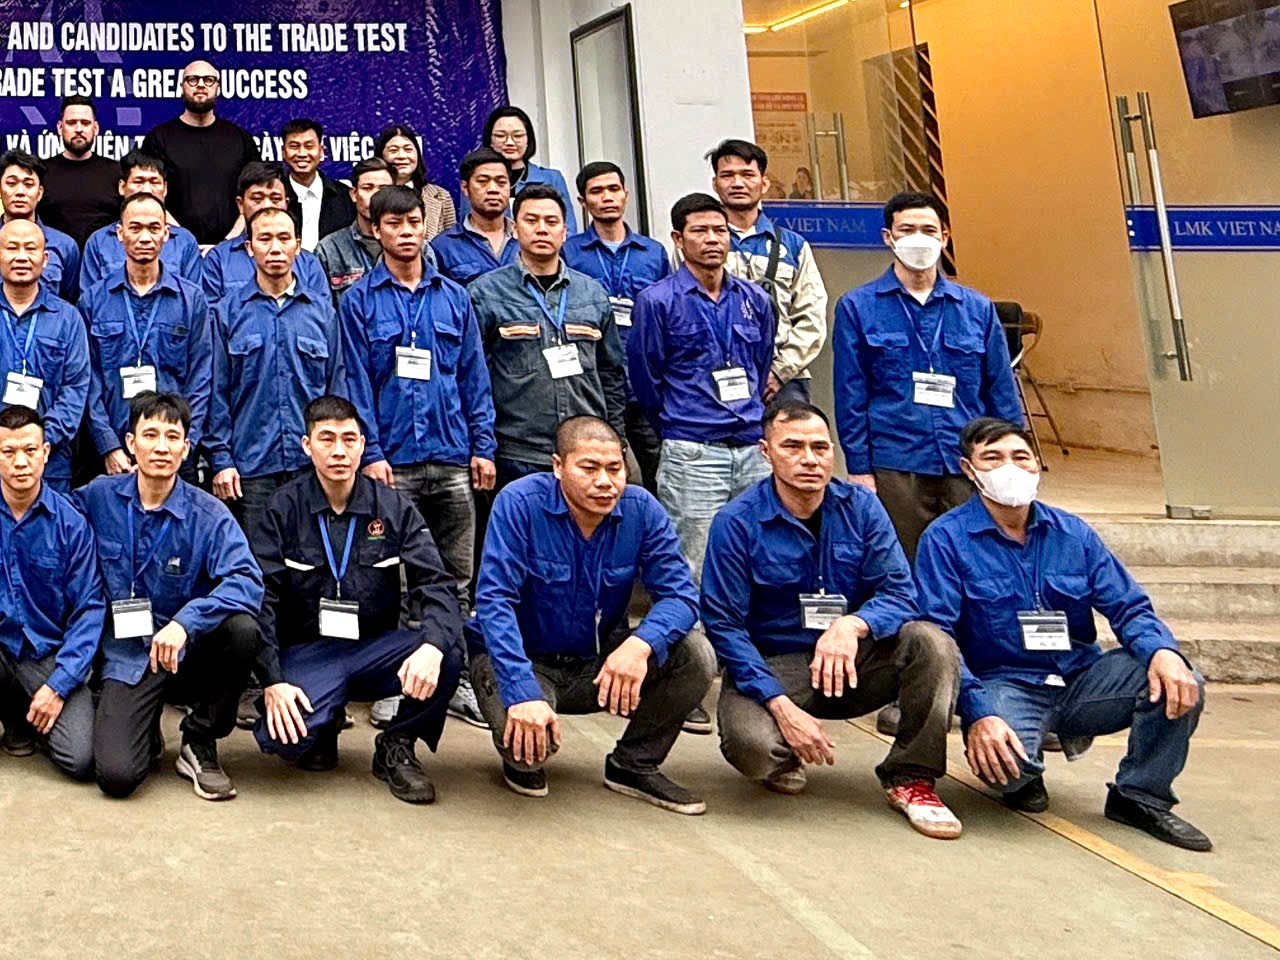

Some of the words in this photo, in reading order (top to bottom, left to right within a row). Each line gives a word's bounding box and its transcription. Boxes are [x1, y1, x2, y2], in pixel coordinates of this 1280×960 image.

[7, 21, 54, 51] AND
[61, 22, 195, 52] CANDIDATES
[200, 22, 227, 52] TO
[233, 23, 273, 52] THE
[278, 23, 349, 52] TRADE
[353, 22, 407, 52] TEST
[51, 67, 105, 97] TEST
[110, 68, 127, 98] A
[132, 68, 185, 98] GREA
[217, 68, 309, 99] UCCESS
[6, 129, 32, 155] VÀ
[37, 129, 65, 160] ỨN
[91, 130, 130, 161] IÊN
[329, 131, 375, 169] VIỆC
[785, 217, 825, 233] VIET
[827, 217, 867, 233] NAM
[1174, 221, 1213, 236] LMK
[1216, 221, 1257, 236] VIET
